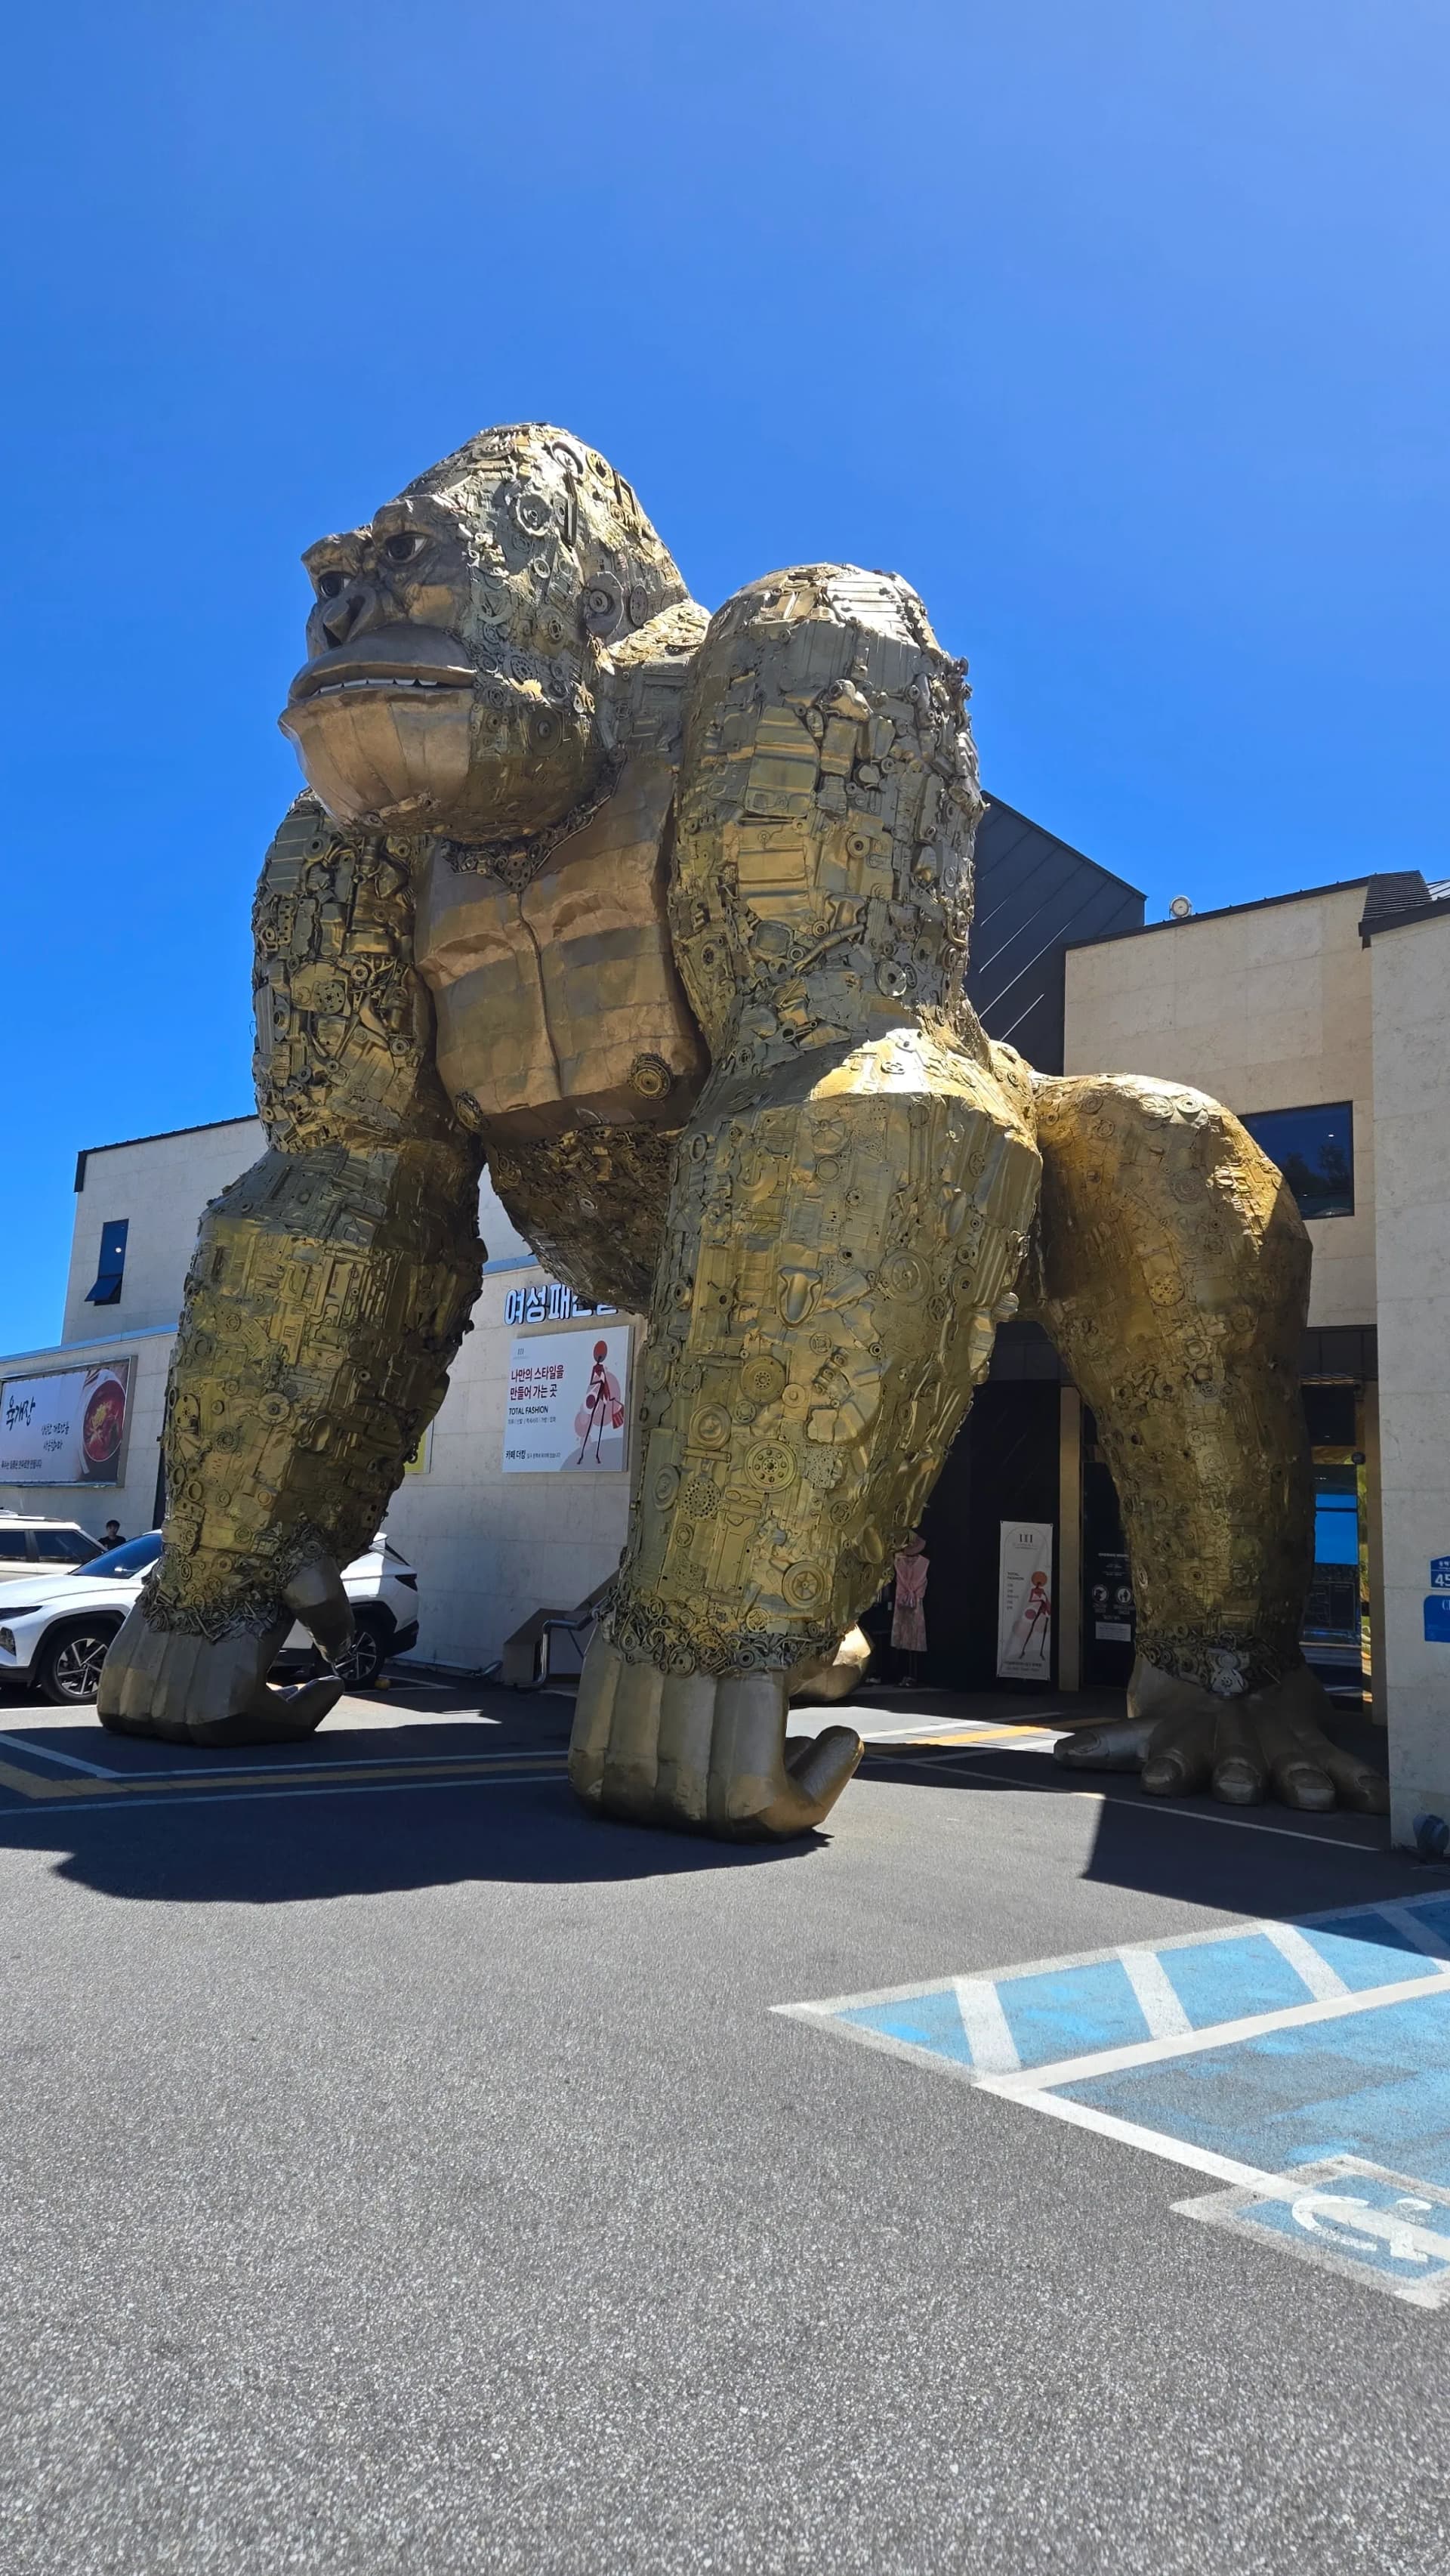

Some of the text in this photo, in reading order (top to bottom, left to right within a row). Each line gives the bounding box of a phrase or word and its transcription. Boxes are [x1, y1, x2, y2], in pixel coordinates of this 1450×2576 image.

[511, 1364, 564, 1382] 나만의 스타일을
[510, 1383, 558, 1401] 만들어 가는 곳
[6, 1395, 35, 1431] 육개장
[508, 1406, 548, 1416] TOTAL FASHION
[505, 1450, 516, 1460] 카페
